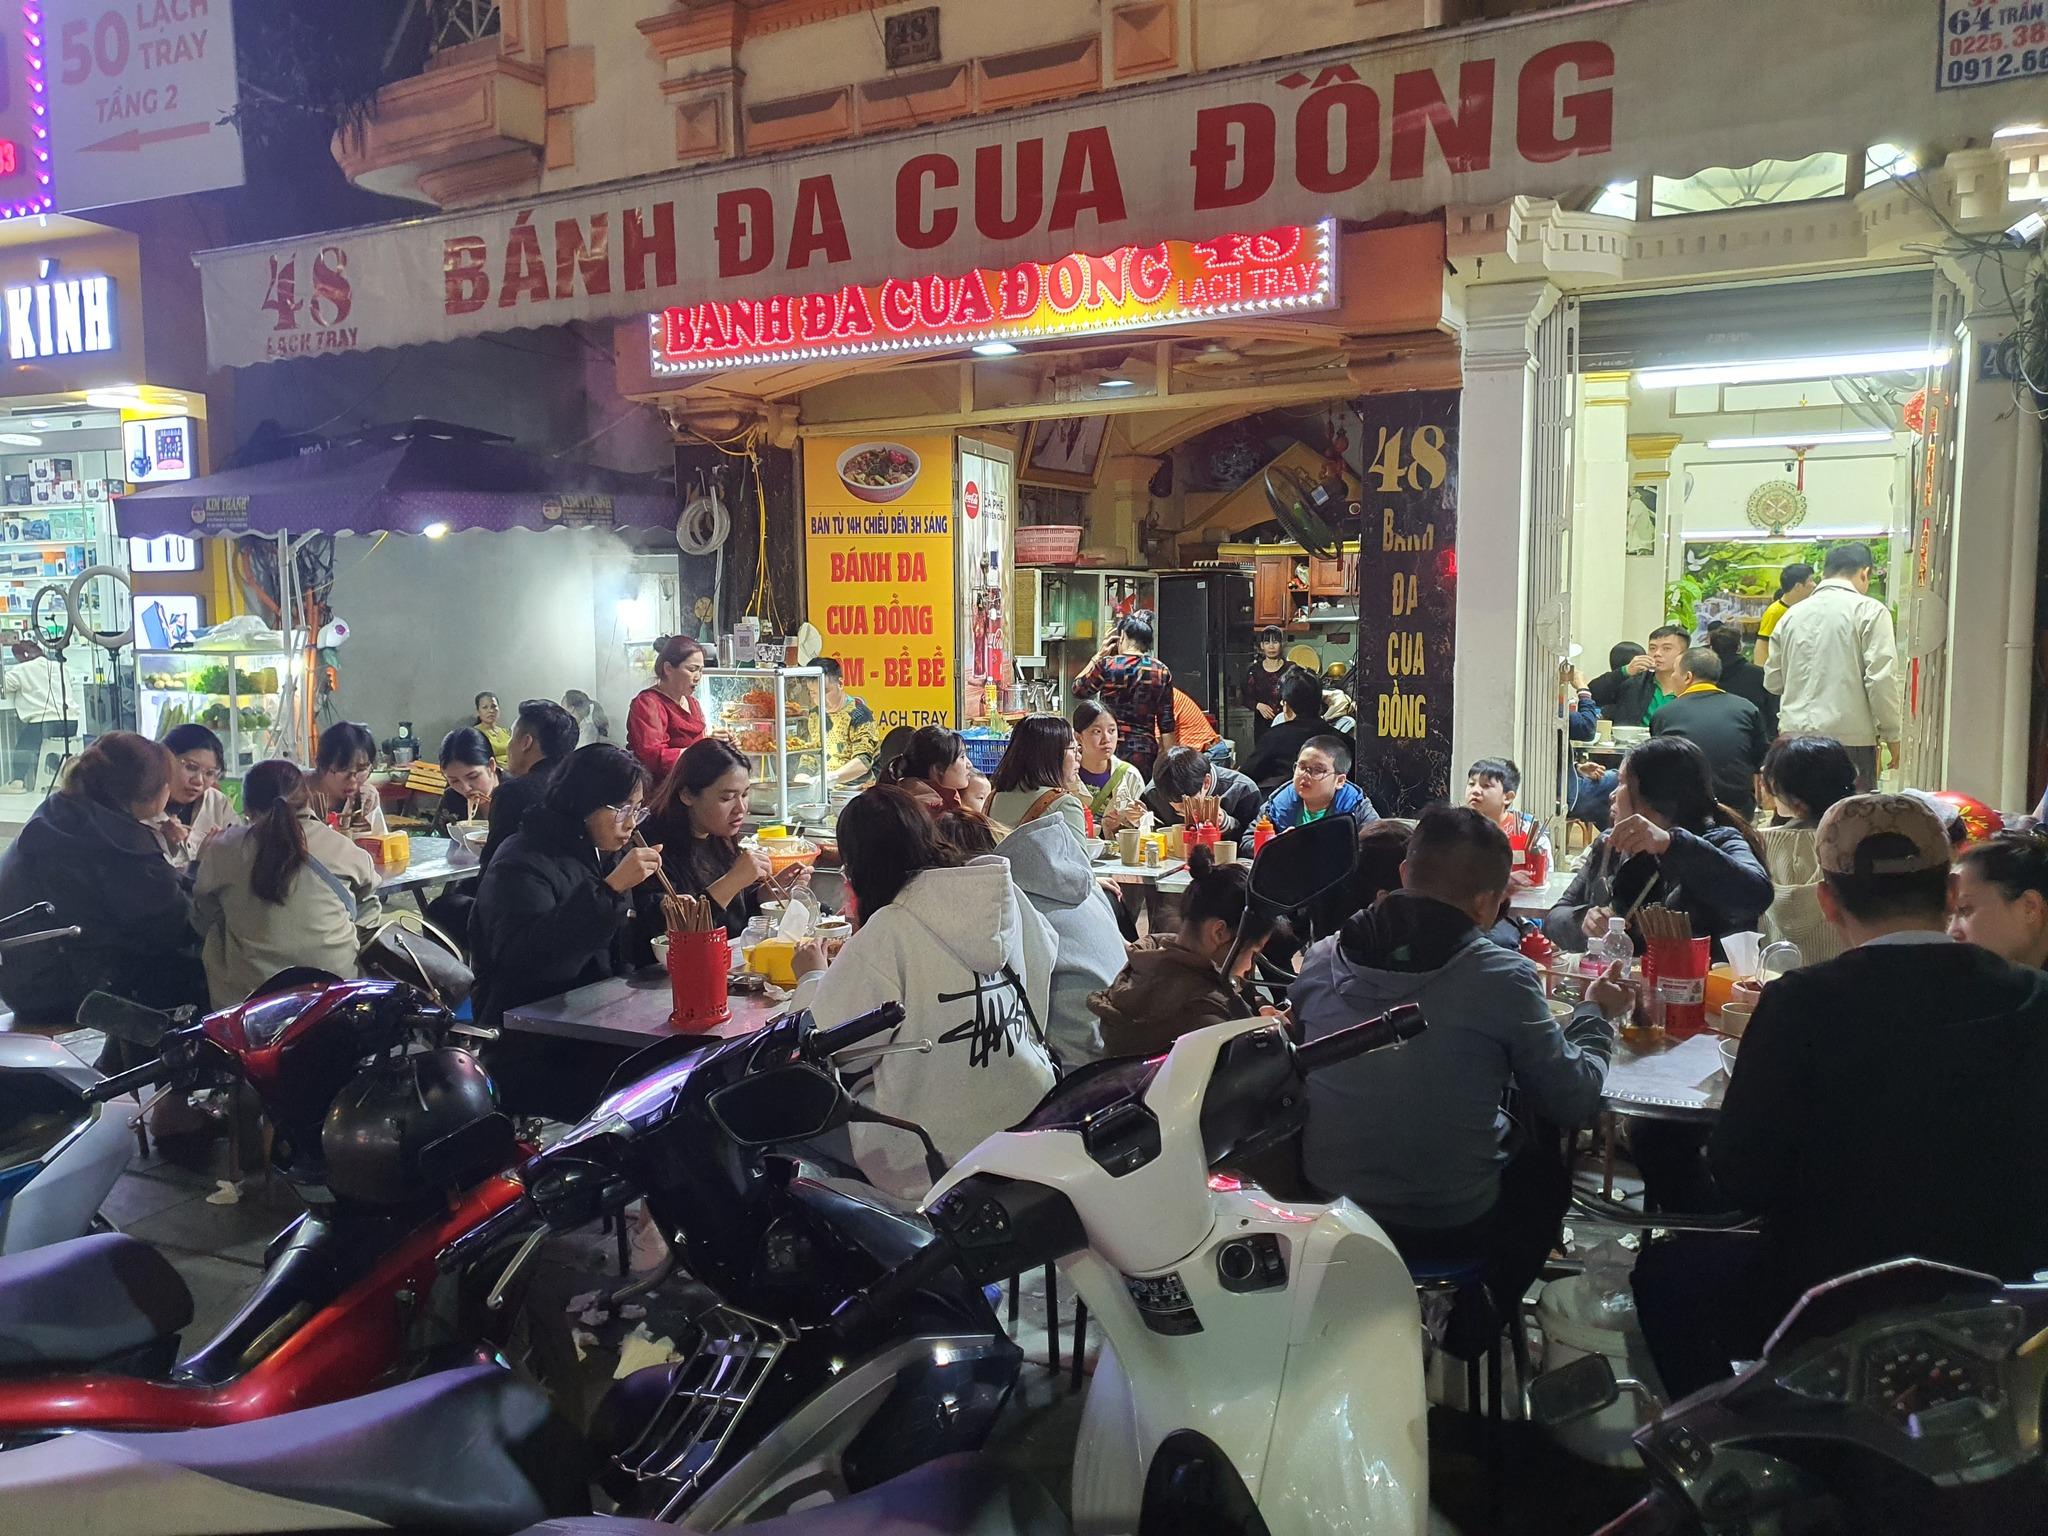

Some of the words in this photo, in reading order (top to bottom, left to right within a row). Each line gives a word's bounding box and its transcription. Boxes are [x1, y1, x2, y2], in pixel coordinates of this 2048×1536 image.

[1948, 7, 1993, 35] 64
[61, 10, 131, 86] 50
[138, 28, 208, 70] TRAY
[96, 85, 158, 123] TẦNG
[164, 84, 178, 111] 2
[443, 200, 677, 316] BÁNH
[714, 174, 852, 279] ĐA
[895, 125, 1127, 250] CUA
[1190, 40, 1615, 212] ĐỒNG
[261, 246, 352, 331] 48
[1247, 261, 1317, 296] TRAY
[5, 259, 112, 360] KÍNH
[800, 285, 876, 341] ĐA
[880, 267, 995, 332] CUA
[316, 327, 358, 351] TRAY
[1368, 425, 1447, 492] 48
[811, 512, 830, 534] BÁN
[847, 516, 861, 534] 14H
[864, 509, 888, 534] CHIỀU
[911, 516, 921, 534] 3H
[924, 510, 947, 533] SÁNG
[830, 546, 892, 583] BÁNH
[897, 551, 928, 583] ĐA
[826, 604, 869, 635] CUA
[1387, 631, 1425, 676] CUA
[877, 710, 908, 731] ẠCH
[912, 710, 948, 727] TRAY
[1377, 679, 1426, 738] ĐỒNG
